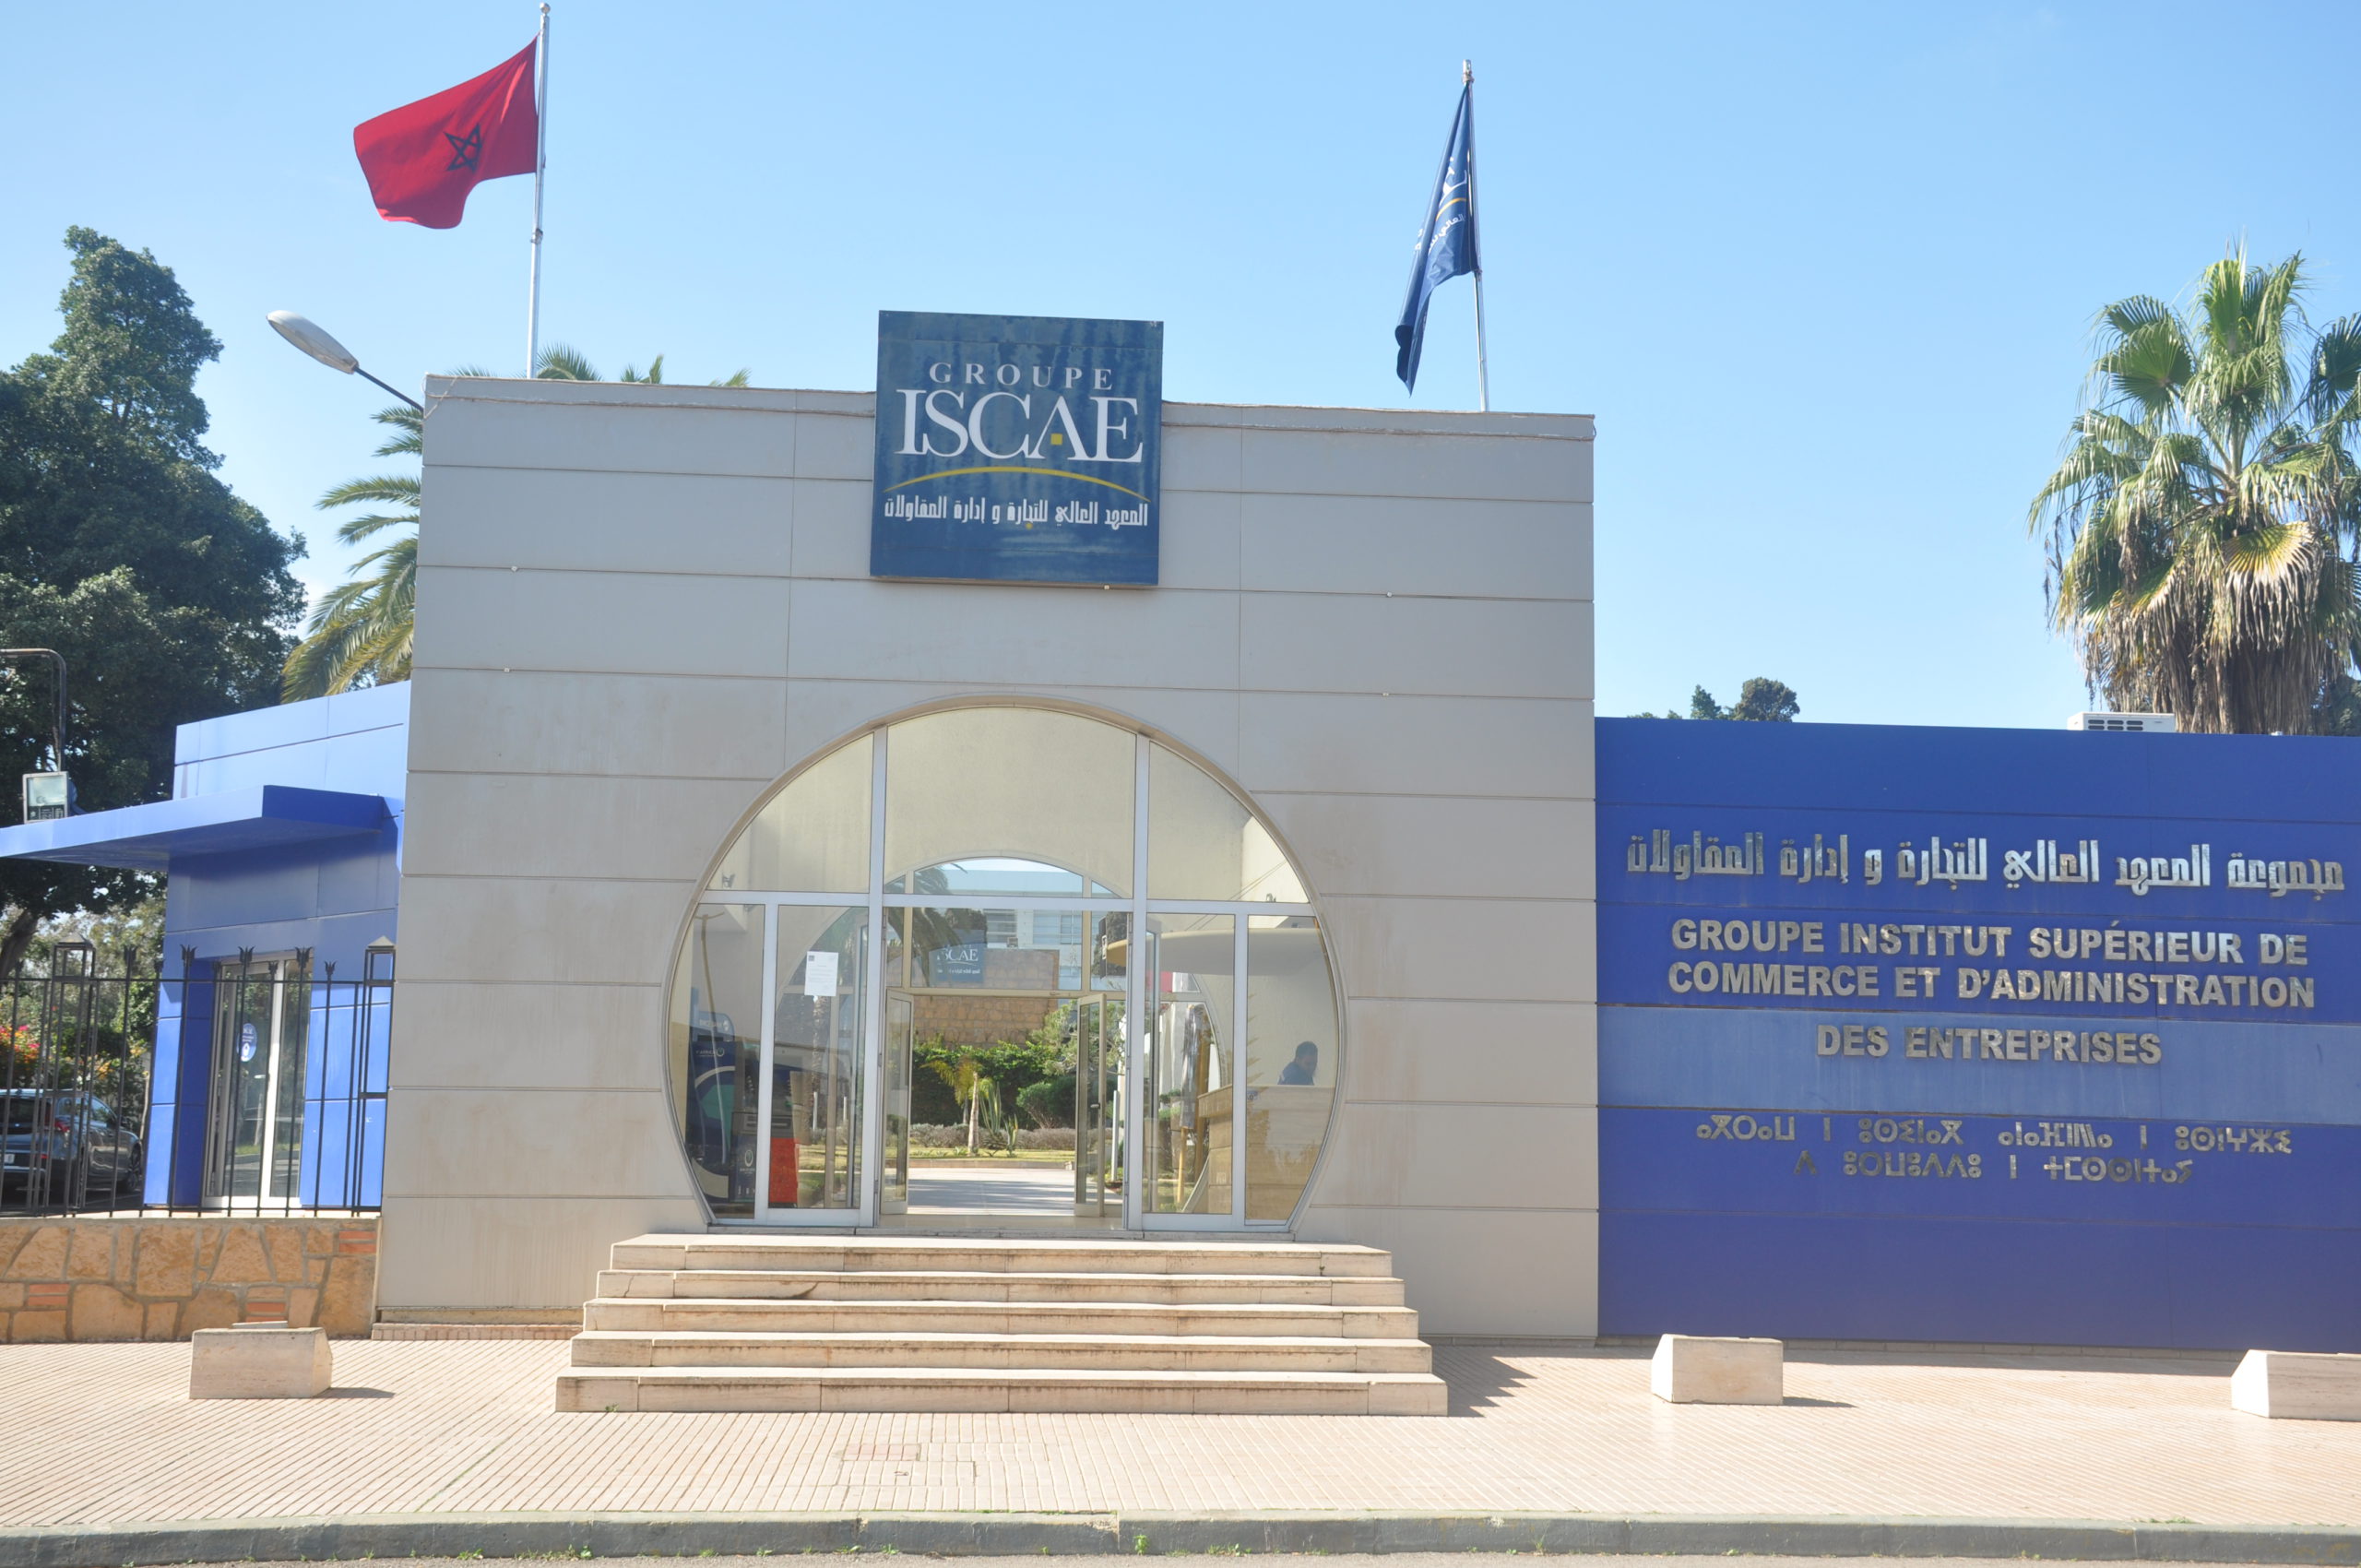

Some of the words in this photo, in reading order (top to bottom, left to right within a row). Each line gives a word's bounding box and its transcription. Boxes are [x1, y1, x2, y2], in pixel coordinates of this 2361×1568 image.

[930, 362, 1112, 389] GROUPE
[896, 389, 1143, 462] ISCAE
[884, 495, 946, 521] المقاولات
[954, 497, 985, 523] إدارة
[992, 505, 1000, 524] و
[1055, 501, 1097, 526] العالي
[1106, 504, 1147, 529] المعهد
[1628, 829, 1763, 881] المقاولات
[1780, 834, 1848, 885] إدارة
[1865, 849, 1882, 885] و
[1898, 837, 1987, 890] للتجارة
[2003, 840, 2099, 889] العالي
[2116, 844, 2210, 896] المعهد
[2227, 853, 2344, 900] مجموعة
[1672, 919, 1823, 952] GROUPE
[1840, 922, 2011, 956] INSTITUT
[2030, 921, 2243, 964] SUPÉRIEUR
[2260, 933, 2308, 965] DE
[1668, 961, 1879, 995] COMMERCE
[1895, 967, 1940, 997] ET
[1817, 1025, 1890, 1057] DES
[1904, 1027, 2162, 1063] ENTREPRISES
